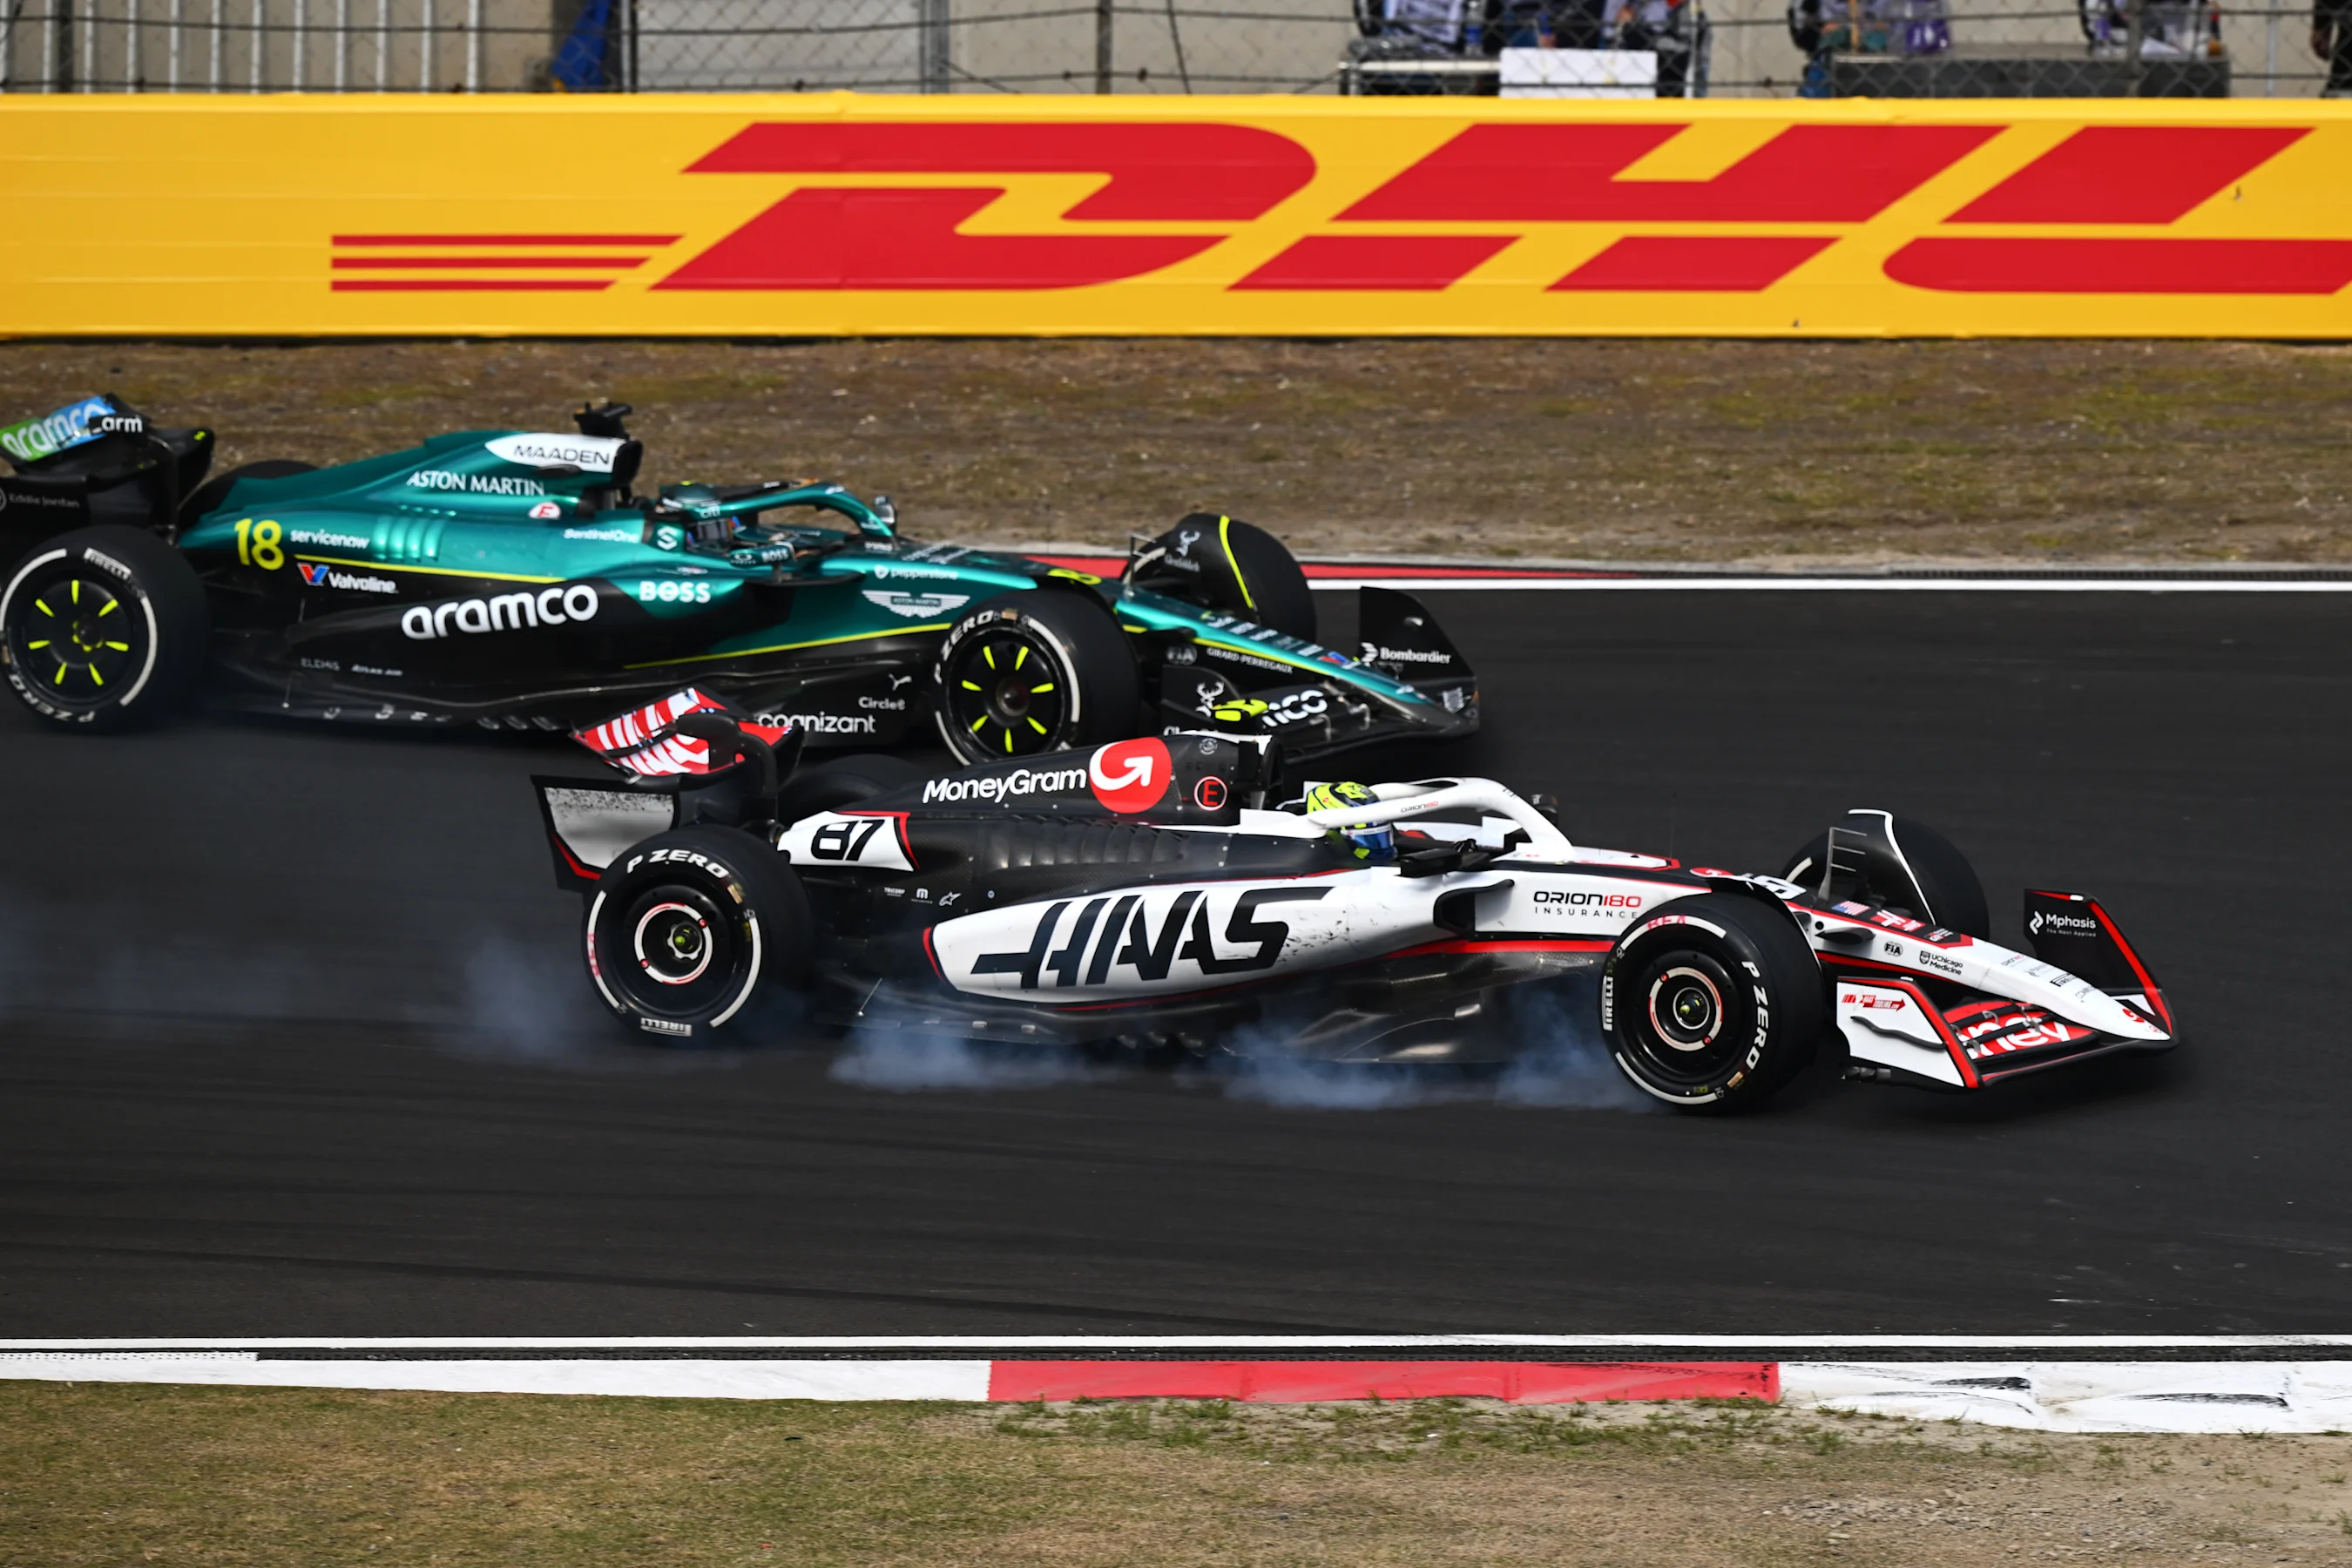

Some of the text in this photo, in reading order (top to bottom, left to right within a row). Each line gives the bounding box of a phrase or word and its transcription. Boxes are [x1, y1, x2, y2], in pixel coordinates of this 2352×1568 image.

[646, 122, 2352, 294] DHL
[514, 445, 611, 465] MAADEN
[406, 470, 544, 496] ASTON MARTIN
[234, 518, 284, 571] 18
[290, 529, 369, 549] servicenow
[564, 528, 639, 544] SentinelOne
[328, 572, 398, 593] Valvoline
[890, 568, 958, 580] pepperstone
[639, 581, 711, 603] BOSS
[402, 585, 598, 639] aramco
[941, 610, 995, 661] ZERO
[1380, 647, 1450, 665] Bombardier
[923, 767, 1086, 804] MoneyGram
[1202, 781, 1220, 806] E
[811, 820, 884, 862] 87
[627, 848, 730, 878] P ZERO
[1533, 891, 1642, 909] ORION180
[1535, 906, 1638, 919] INSURANCE
[2046, 914, 2097, 929] Mphasis
[970, 887, 1336, 989] HAAS
[1884, 943, 1902, 956] FIA
[1930, 961, 1962, 976] Medicine
[1932, 954, 1963, 969] UChicago
[1741, 961, 1768, 1071] P ZERO
